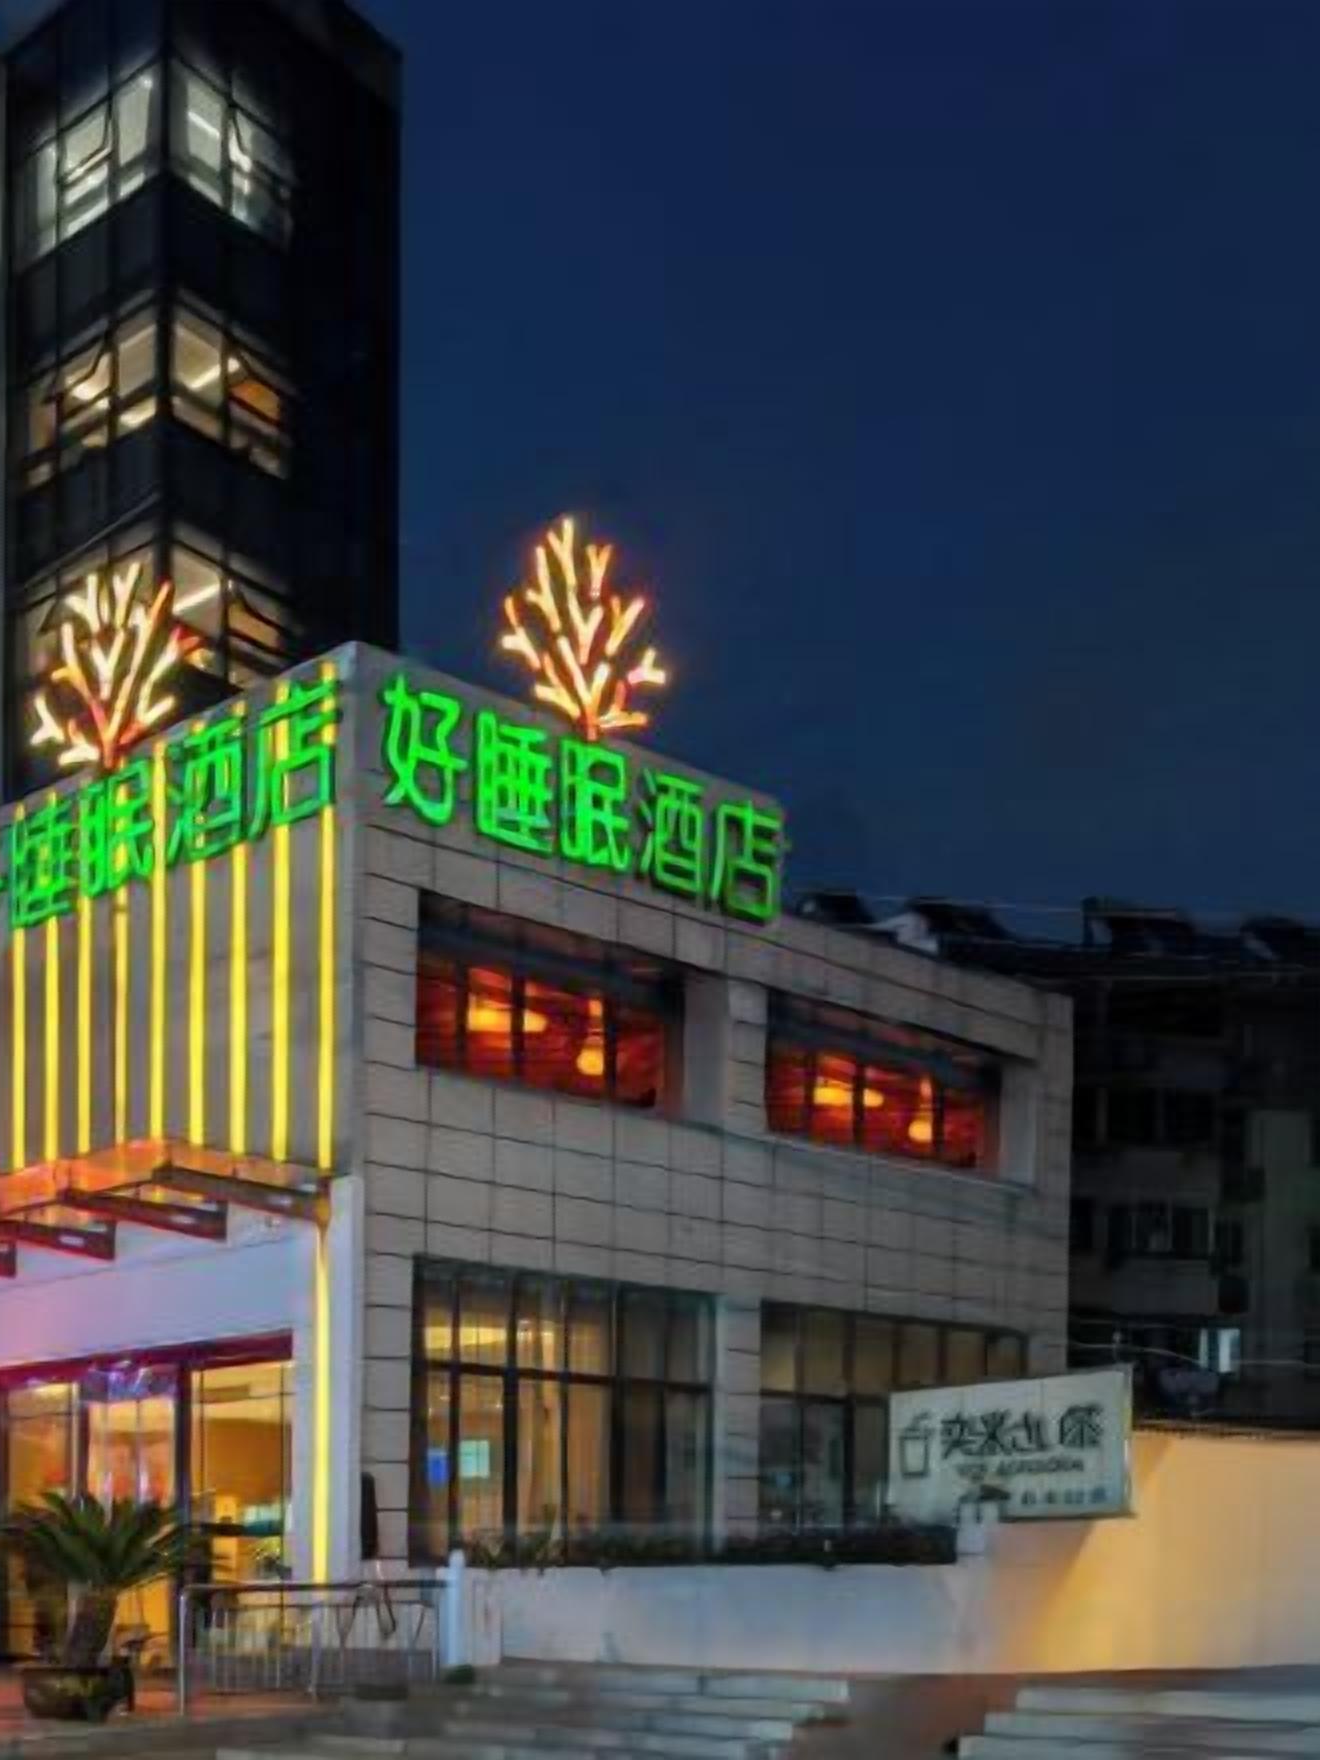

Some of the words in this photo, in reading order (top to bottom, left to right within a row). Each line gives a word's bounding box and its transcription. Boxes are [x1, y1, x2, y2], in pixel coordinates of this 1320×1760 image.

[381, 672, 782, 918] 好睡眠酒店
